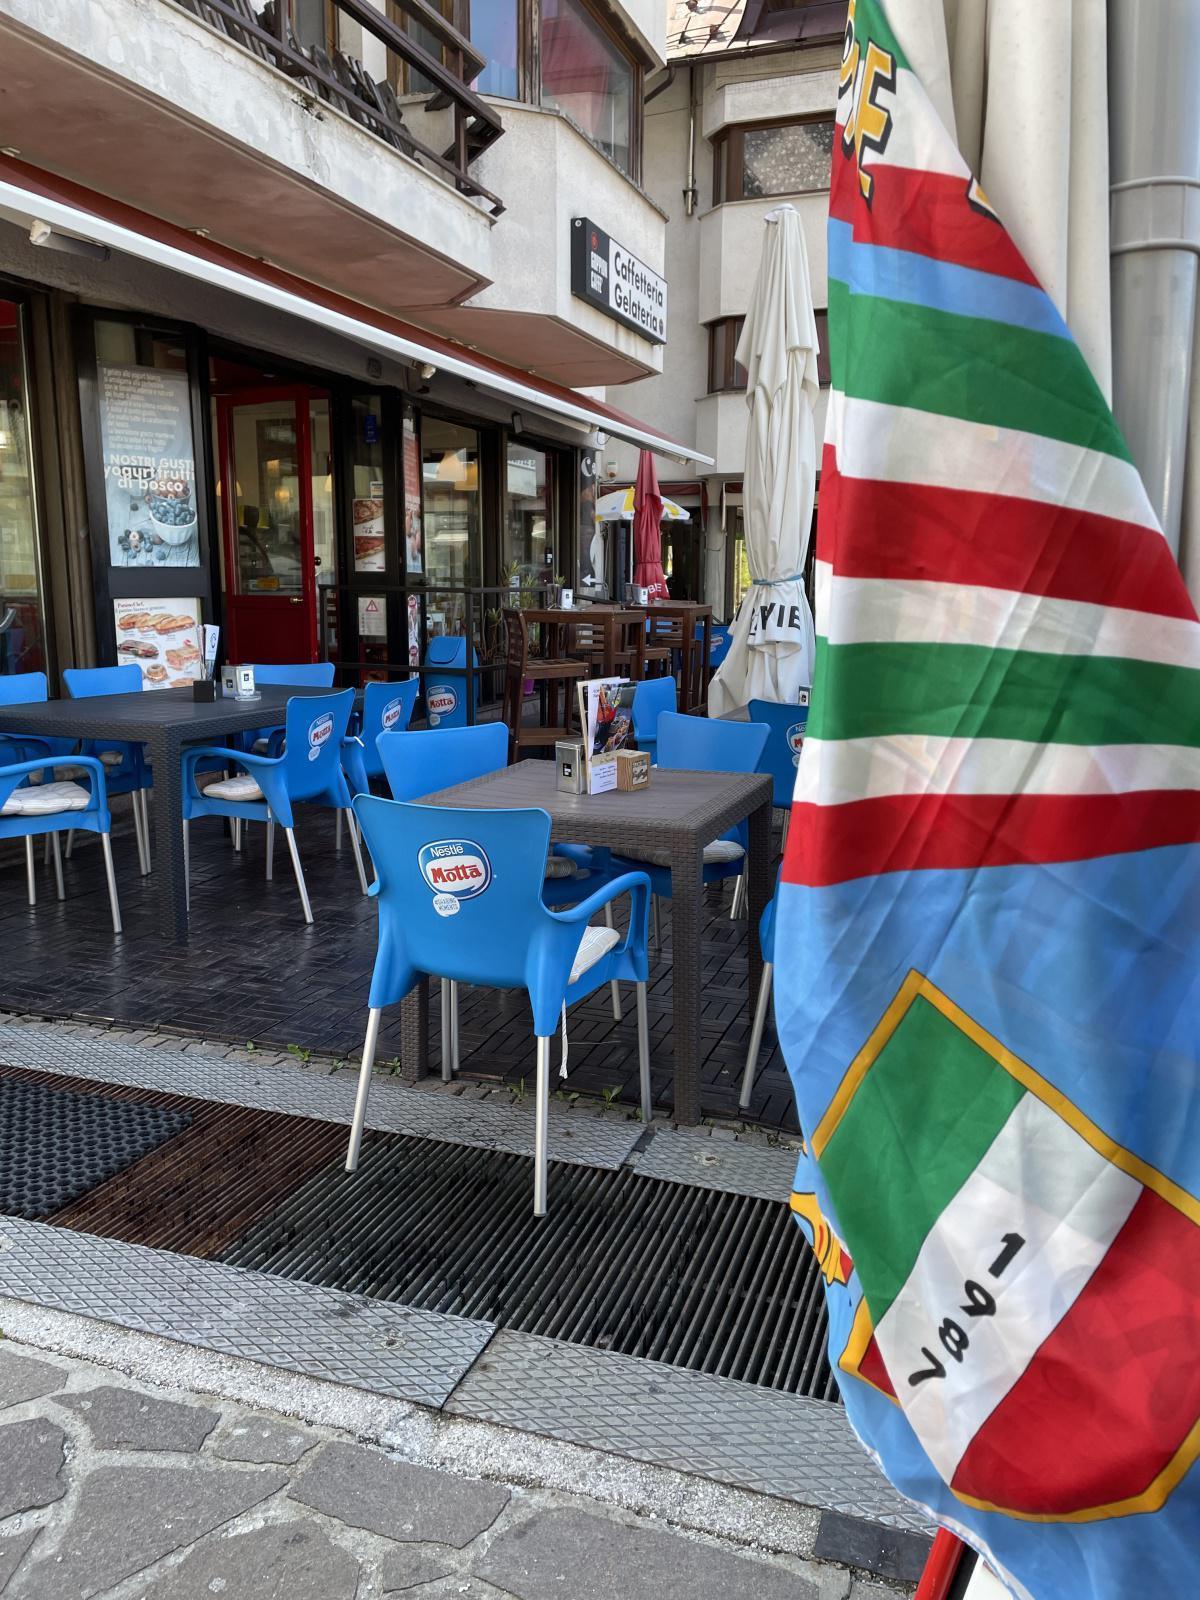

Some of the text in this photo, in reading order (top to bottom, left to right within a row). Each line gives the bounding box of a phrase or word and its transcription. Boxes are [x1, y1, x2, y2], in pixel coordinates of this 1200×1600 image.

[614, 250, 663, 308] Caffetteria
[614, 282, 658, 333] Gelateria
[110, 454, 155, 467] NOSTRI
[103, 466, 195, 481] yogurt frutti
[118, 472, 183, 492] di bosco
[430, 697, 454, 709] Motta
[429, 843, 464, 858] Nestlé
[430, 864, 483, 884] Motta
